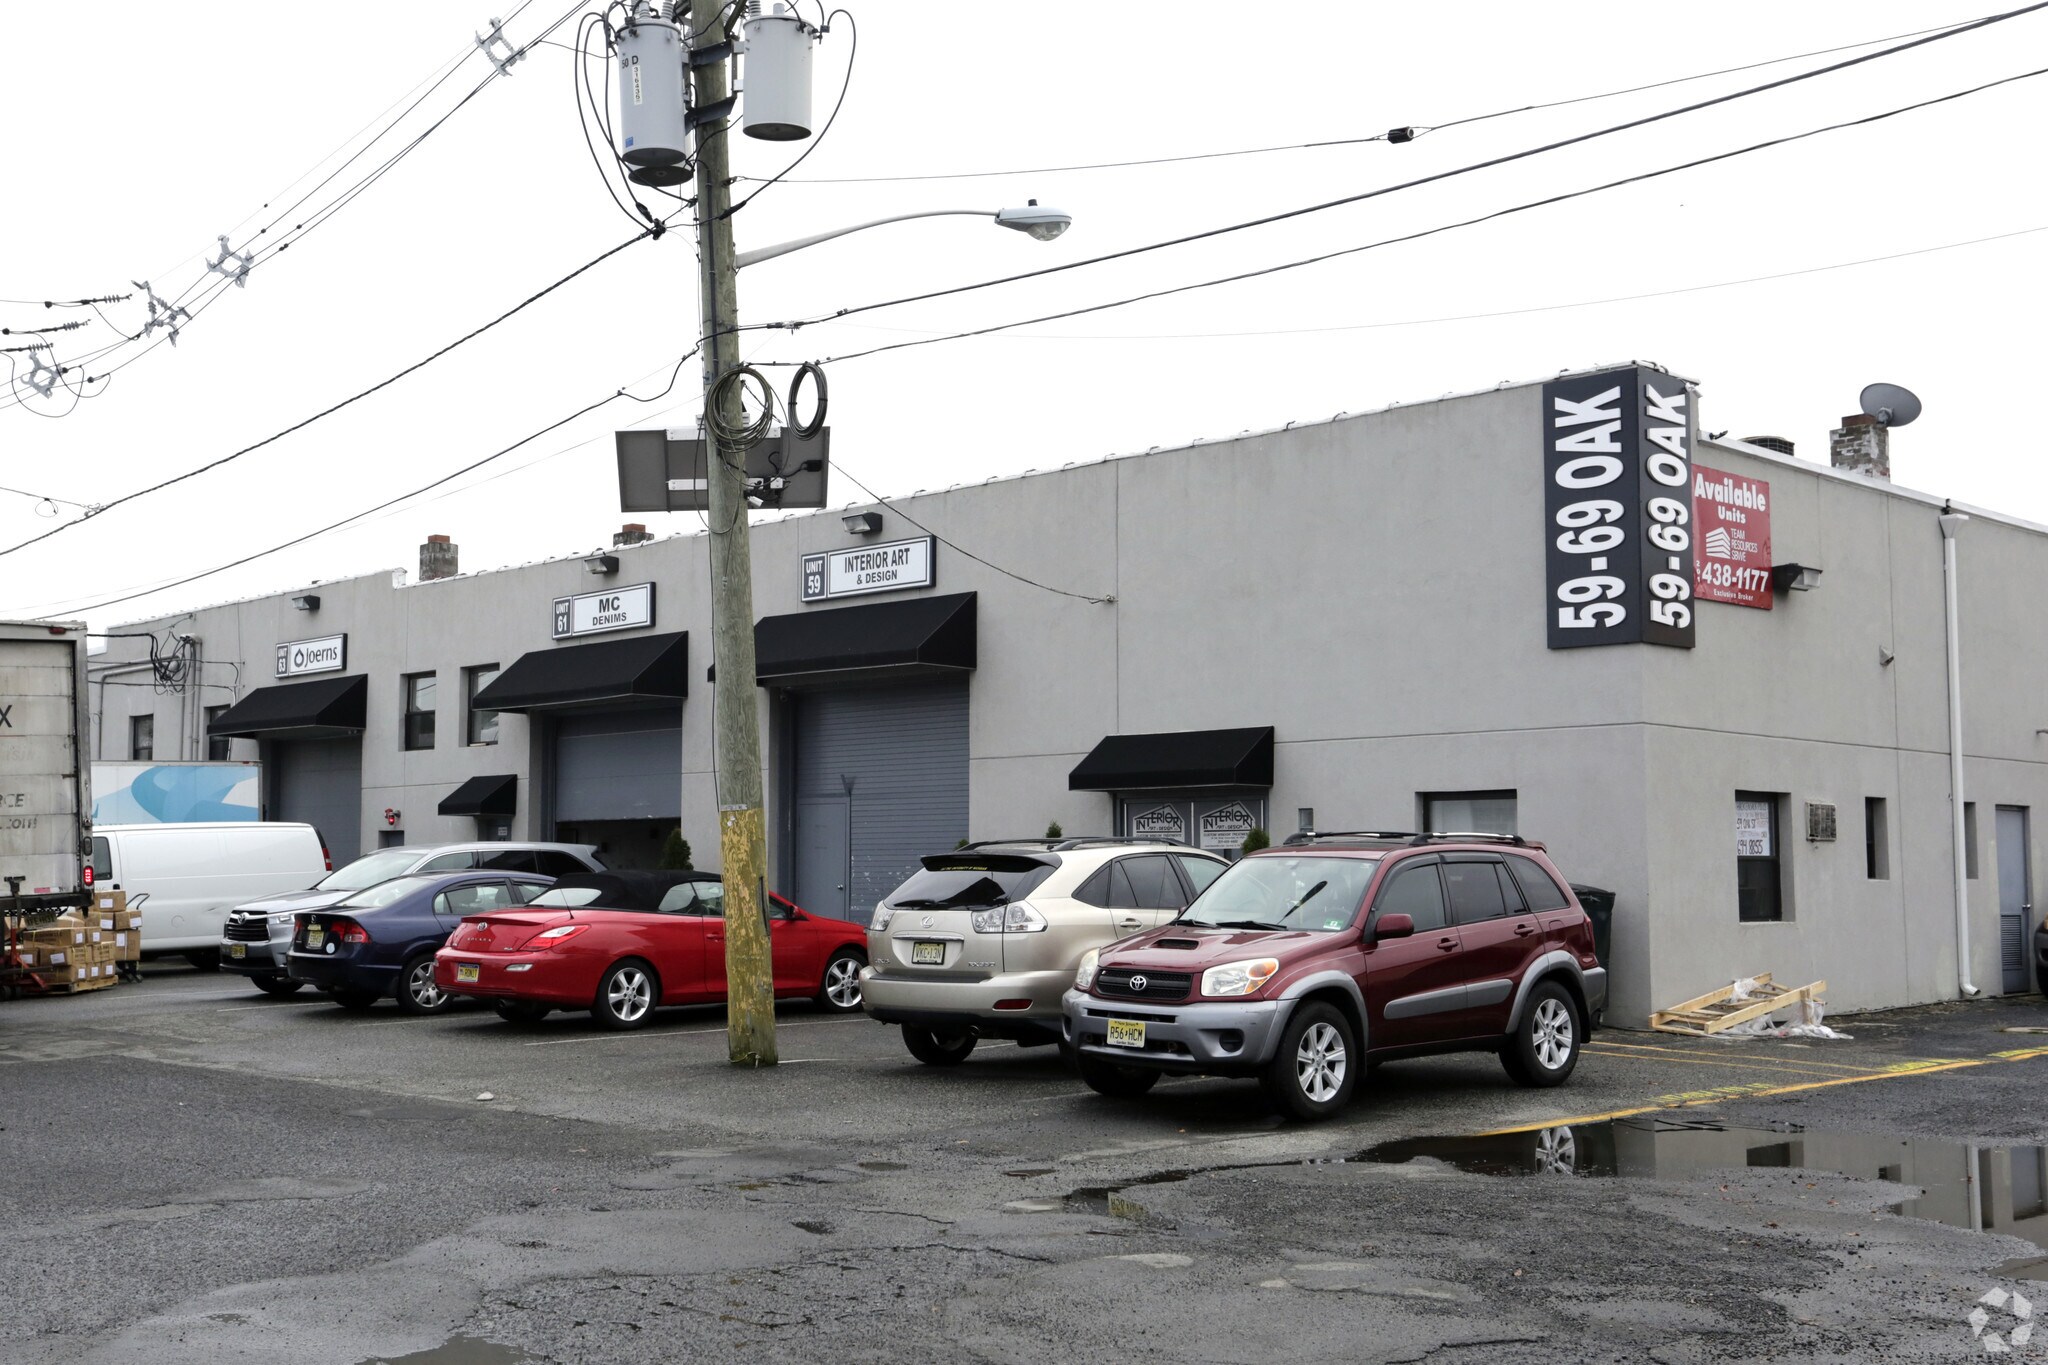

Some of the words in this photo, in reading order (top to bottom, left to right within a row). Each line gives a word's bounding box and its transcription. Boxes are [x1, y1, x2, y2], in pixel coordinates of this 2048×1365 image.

[632, 55, 638, 65] D
[1554, 386, 1624, 490] OAK
[1646, 384, 1688, 487] OAK
[1694, 473, 1766, 512] Available
[1718, 505, 1746, 524] Units
[1730, 528, 1746, 540] TEAM
[1731, 539, 1758, 553] RESOURCES
[806, 560, 823, 574] UNIT
[844, 551, 888, 574] INTERIOR
[891, 548, 910, 567] ART
[1556, 499, 1627, 628] 59-69
[1648, 497, 1691, 629] 59-69
[808, 574, 821, 594] 59
[856, 574, 862, 585] &
[866, 569, 898, 584] DESIGN
[1702, 562, 1768, 592] 438-1177
[1714, 588, 1737, 599] Exclusive
[1738, 592, 1754, 601] Broker
[556, 602, 569, 614] UNIT
[599, 596, 620, 614] MC
[558, 614, 568, 632] 61
[592, 612, 627, 626] DENIMS
[304, 647, 338, 668] Joerns
[1136, 811, 1182, 831] INTERIOR
[1204, 808, 1252, 830] INTERIOR
